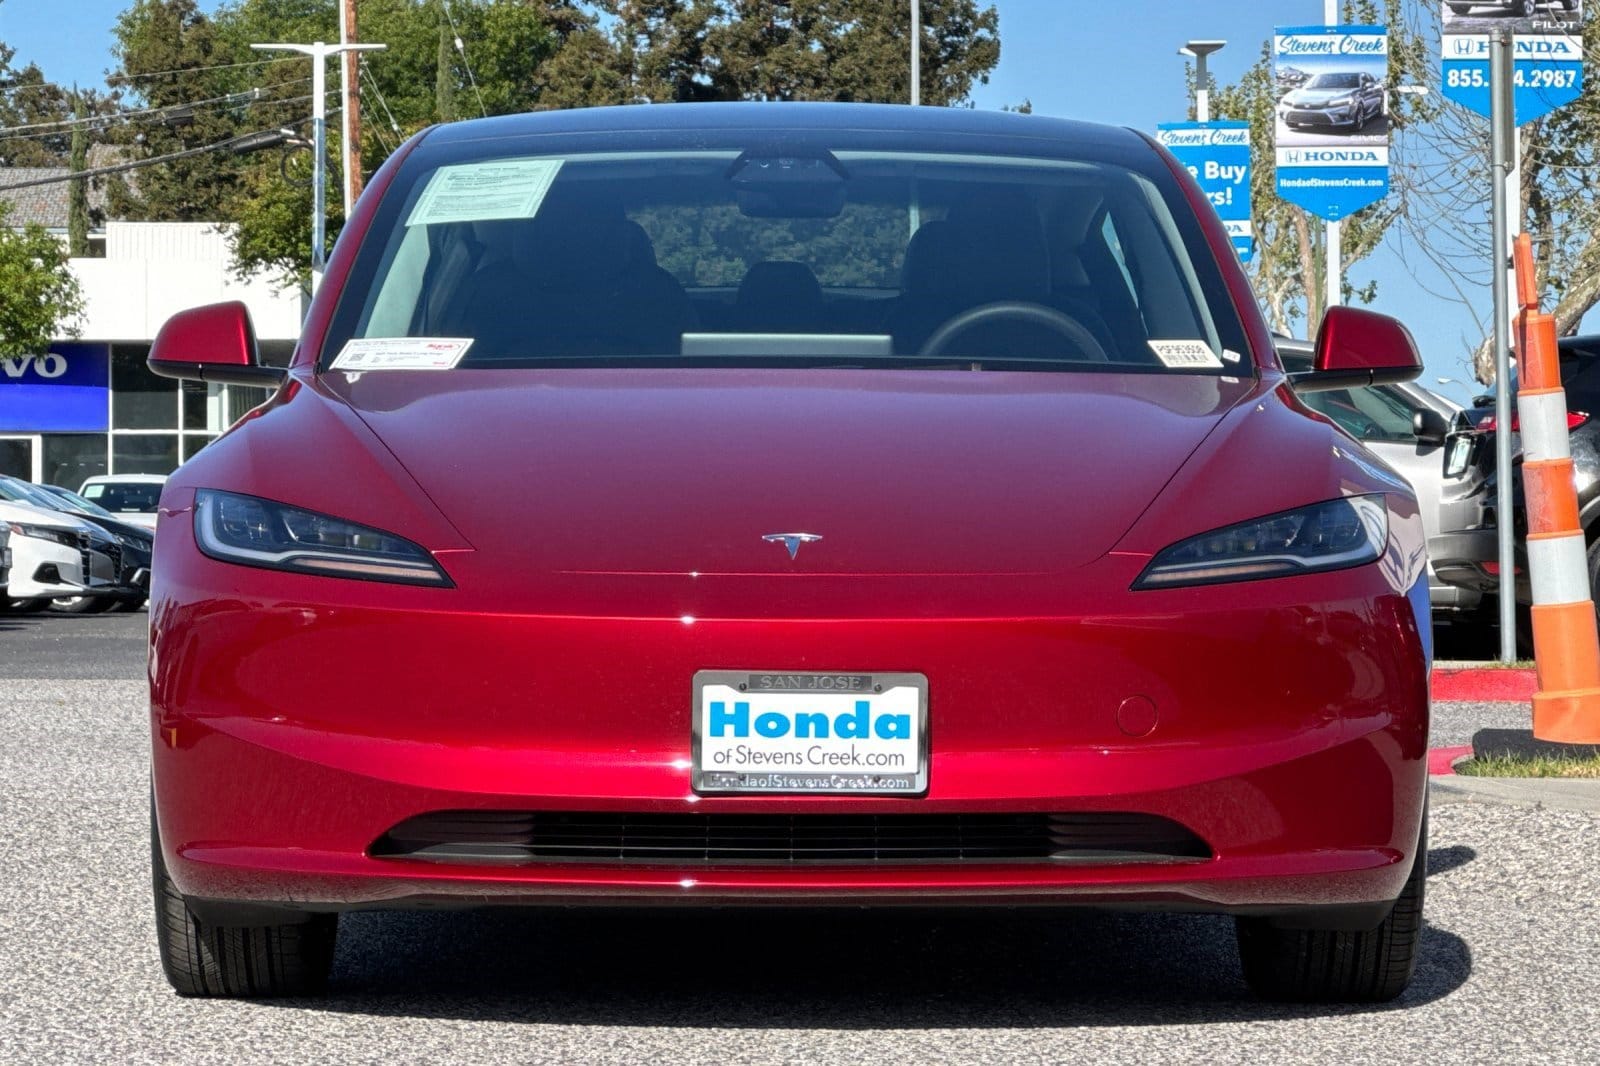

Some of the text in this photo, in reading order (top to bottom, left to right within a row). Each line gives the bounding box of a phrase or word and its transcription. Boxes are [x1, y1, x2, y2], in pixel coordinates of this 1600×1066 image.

[1532, 21, 1577, 29] PILOT
[1279, 35, 1384, 55] Stevens Creek
[1476, 41, 1571, 53] HNDA
[1447, 69, 1577, 88] 855.4.2987
[1161, 130, 1246, 147] Stevens Creek
[1304, 151, 1378, 161] HONDA
[1204, 161, 1246, 184] Buy
[1279, 178, 1384, 187] HondaofStevensCreek.com
[4, 353, 68, 378] VO
[759, 675, 861, 689] SAN JOSE
[709, 701, 911, 739] Honda
[713, 744, 905, 766] of Stevens Creek.com
